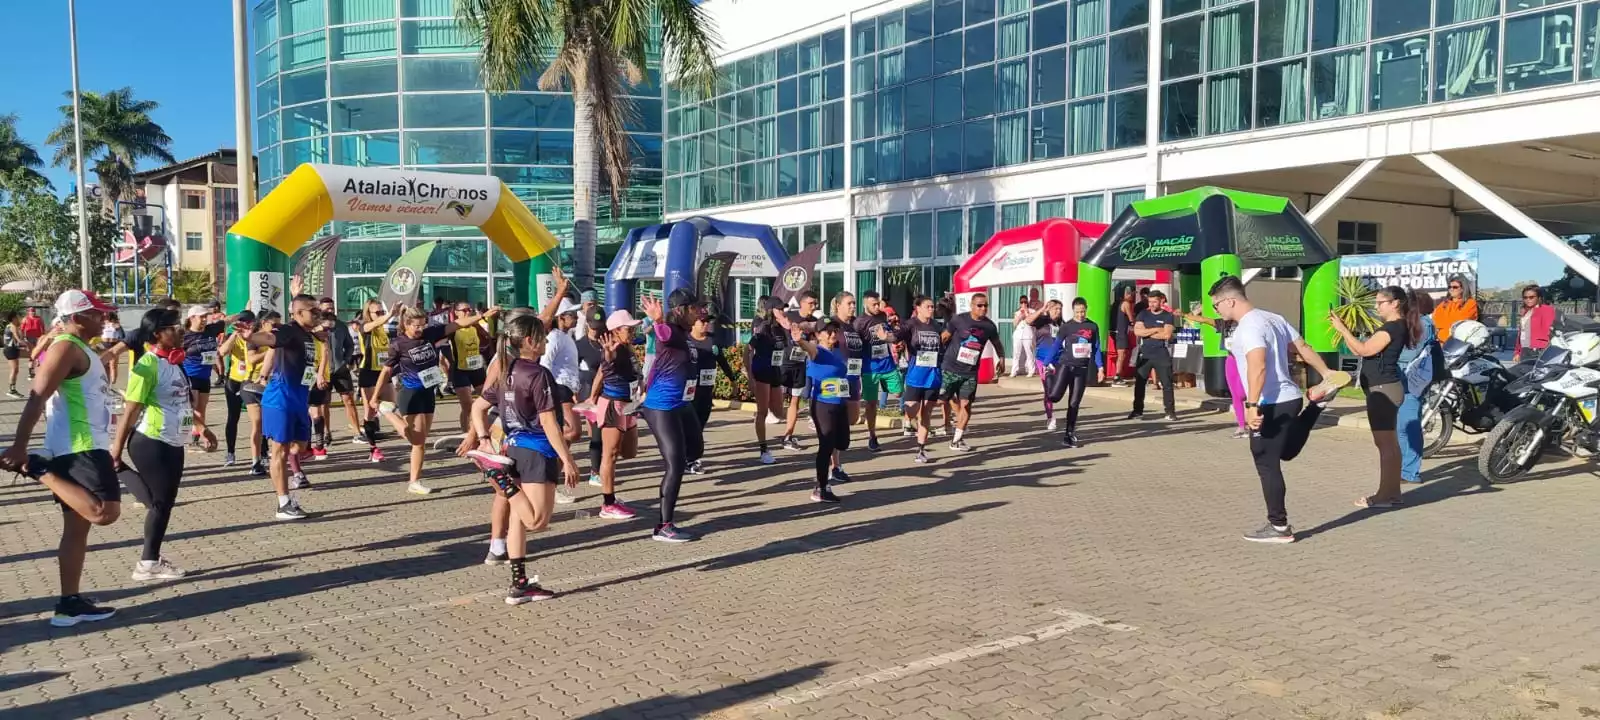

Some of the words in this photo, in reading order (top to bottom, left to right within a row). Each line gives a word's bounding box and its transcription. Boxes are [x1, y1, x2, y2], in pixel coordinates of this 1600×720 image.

[343, 178, 406, 196] Atalaia
[417, 182, 488, 201] Chronos
[347, 195, 392, 213] Vamos
[396, 201, 444, 214] vencer!
[1153, 235, 1194, 246] NAÇÃO
[1150, 244, 1192, 253] FITNESS
